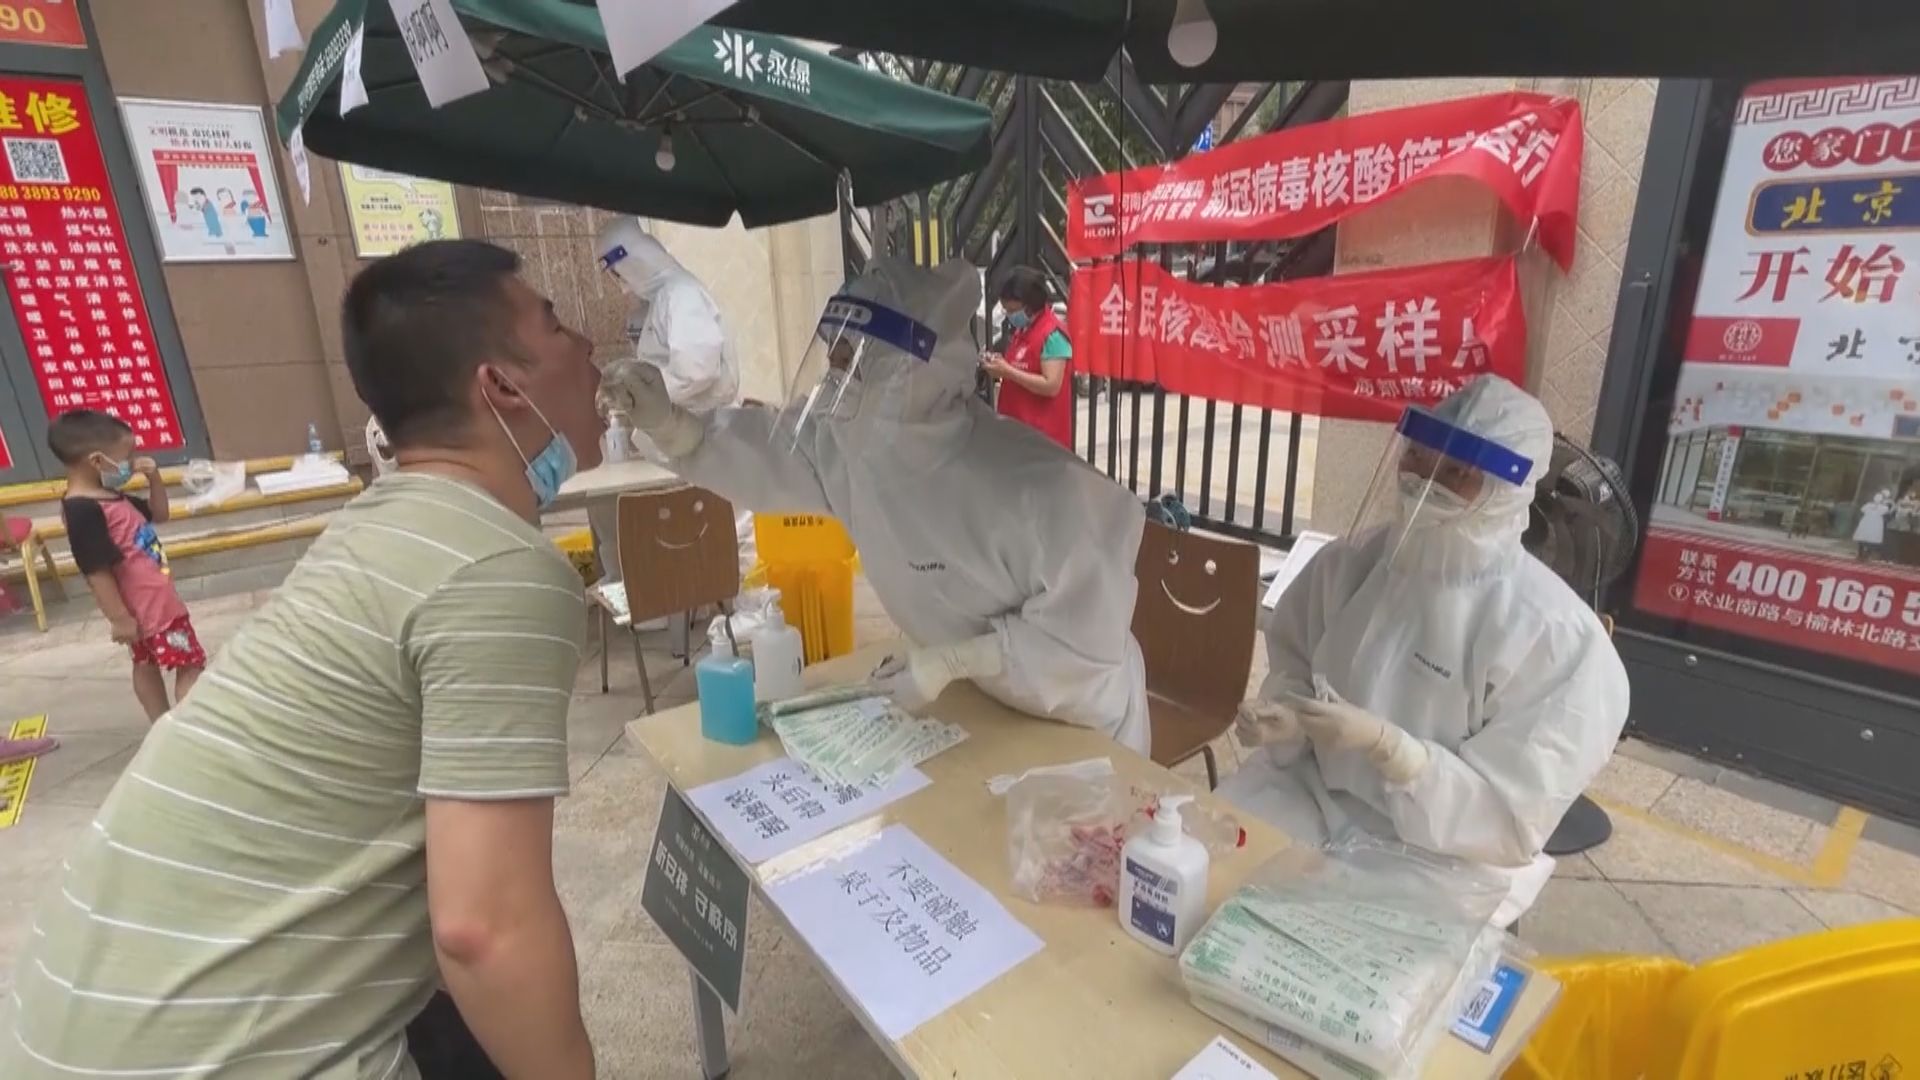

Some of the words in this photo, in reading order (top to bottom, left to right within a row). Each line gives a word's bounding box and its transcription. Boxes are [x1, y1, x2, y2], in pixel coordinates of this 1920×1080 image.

[767, 48, 810, 86] 永绿
[1780, 180, 1902, 229] 北京
[4, 241, 58, 254] 洗衣机
[1736, 244, 1906, 303] 开始
[43, 355, 150, 374] 家电以旧换新
[48, 371, 155, 390] 回收旧家电
[54, 387, 160, 406] 出售二手旧家电
[1679, 549, 1718, 571] 联系
[1676, 566, 1716, 586] 方式
[1727, 560, 1807, 602] 400
[1816, 577, 1895, 619] 166
[835, 869, 952, 977] 桌子及物品
